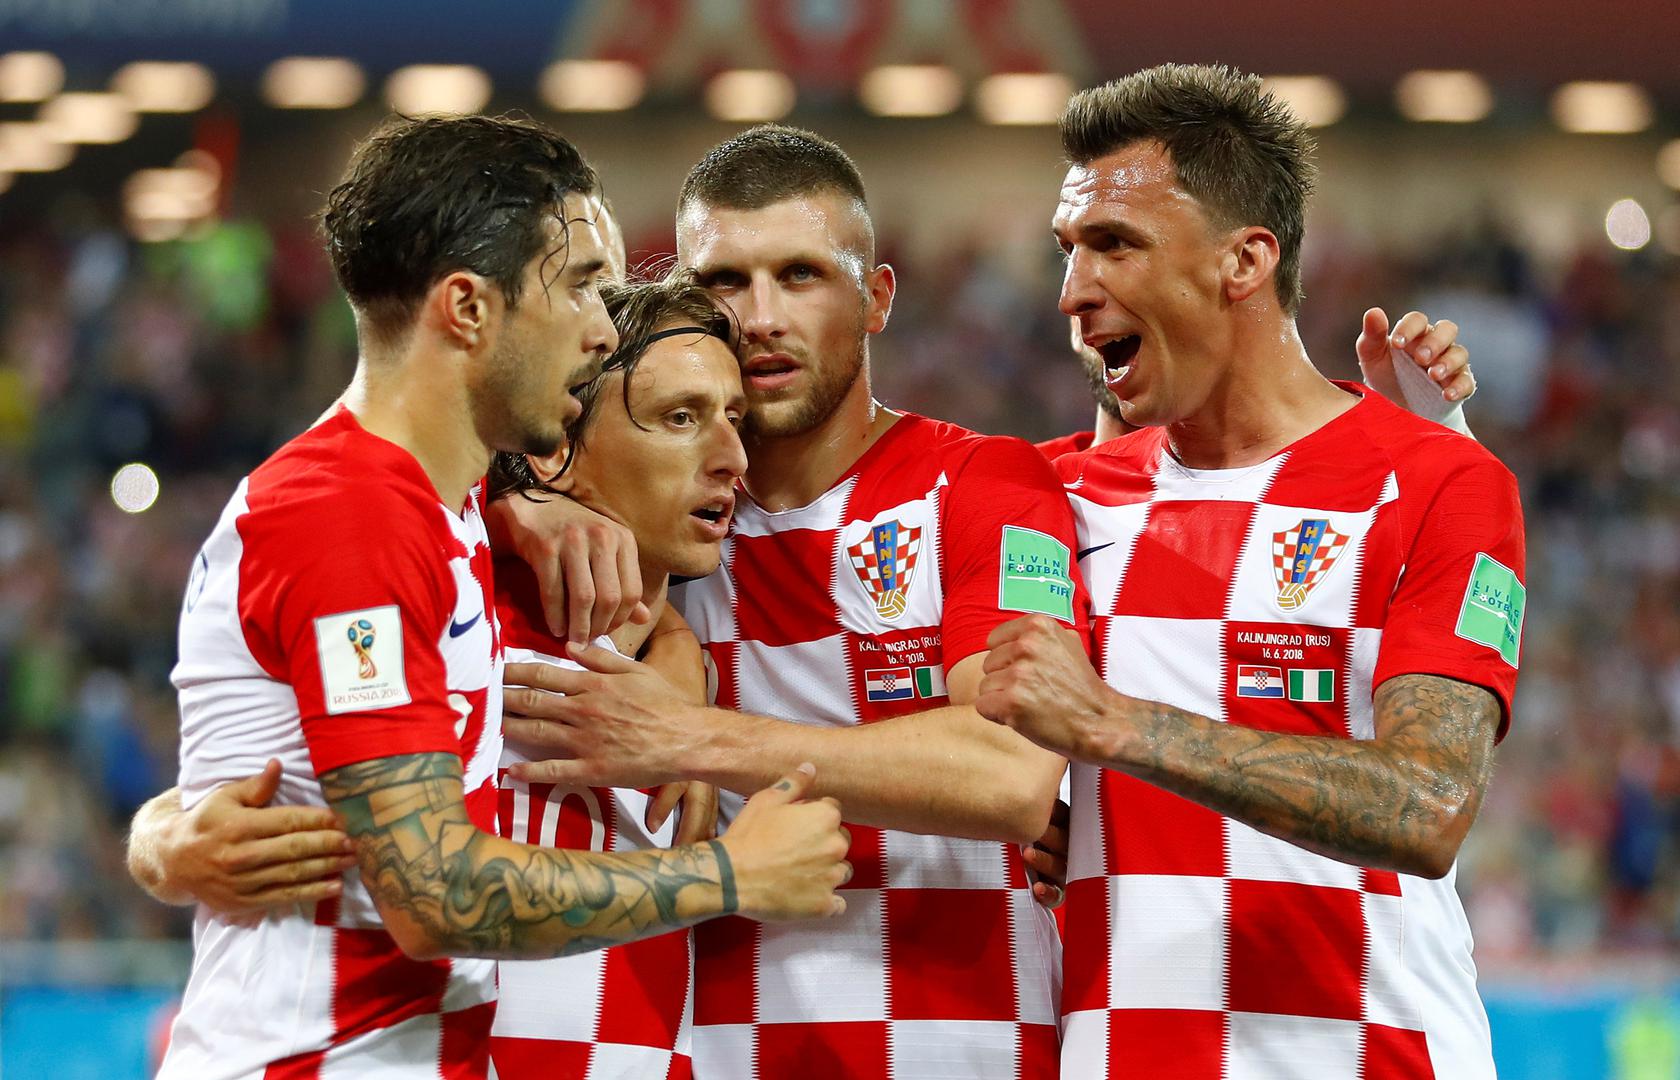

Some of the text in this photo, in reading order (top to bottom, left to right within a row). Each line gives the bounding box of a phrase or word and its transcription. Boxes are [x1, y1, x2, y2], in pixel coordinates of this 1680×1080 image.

[879, 530, 893, 580] HNS
[1295, 526, 1318, 573] HNS
[1008, 553, 1064, 570] LIVIN
[1008, 563, 1066, 579] FOOTBAL
[920, 633, 942, 648] (RUS
[1237, 631, 1331, 647] KALINJINGRAD (RUS)
[334, 690, 380, 704] RUSSIA
[500, 773, 606, 852] 10
